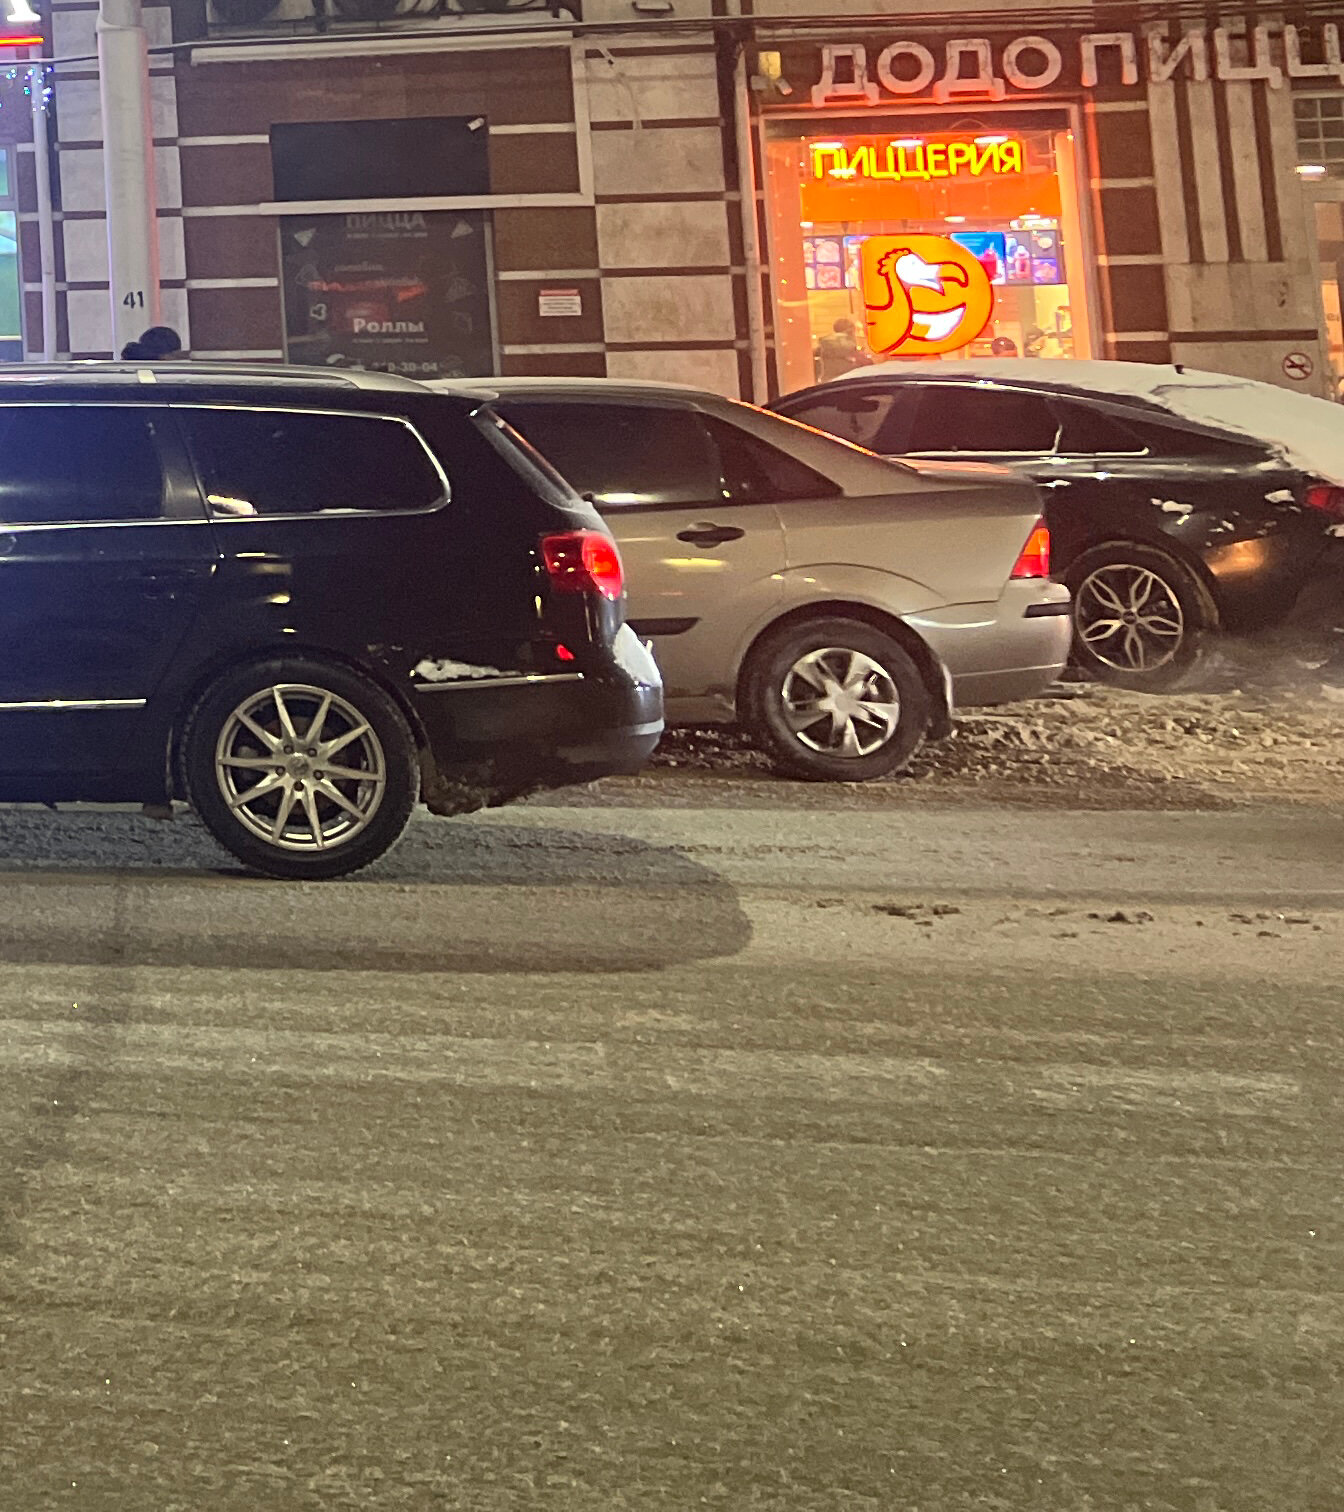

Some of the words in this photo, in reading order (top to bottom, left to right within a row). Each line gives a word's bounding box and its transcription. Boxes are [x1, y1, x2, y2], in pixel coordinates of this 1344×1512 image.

[811, 35, 1063, 108] ДОДО
[813, 140, 1023, 181] ПИЦЦЕРИЯ
[123, 291, 144, 309] 41
[353, 317, 424, 334] Роллы
